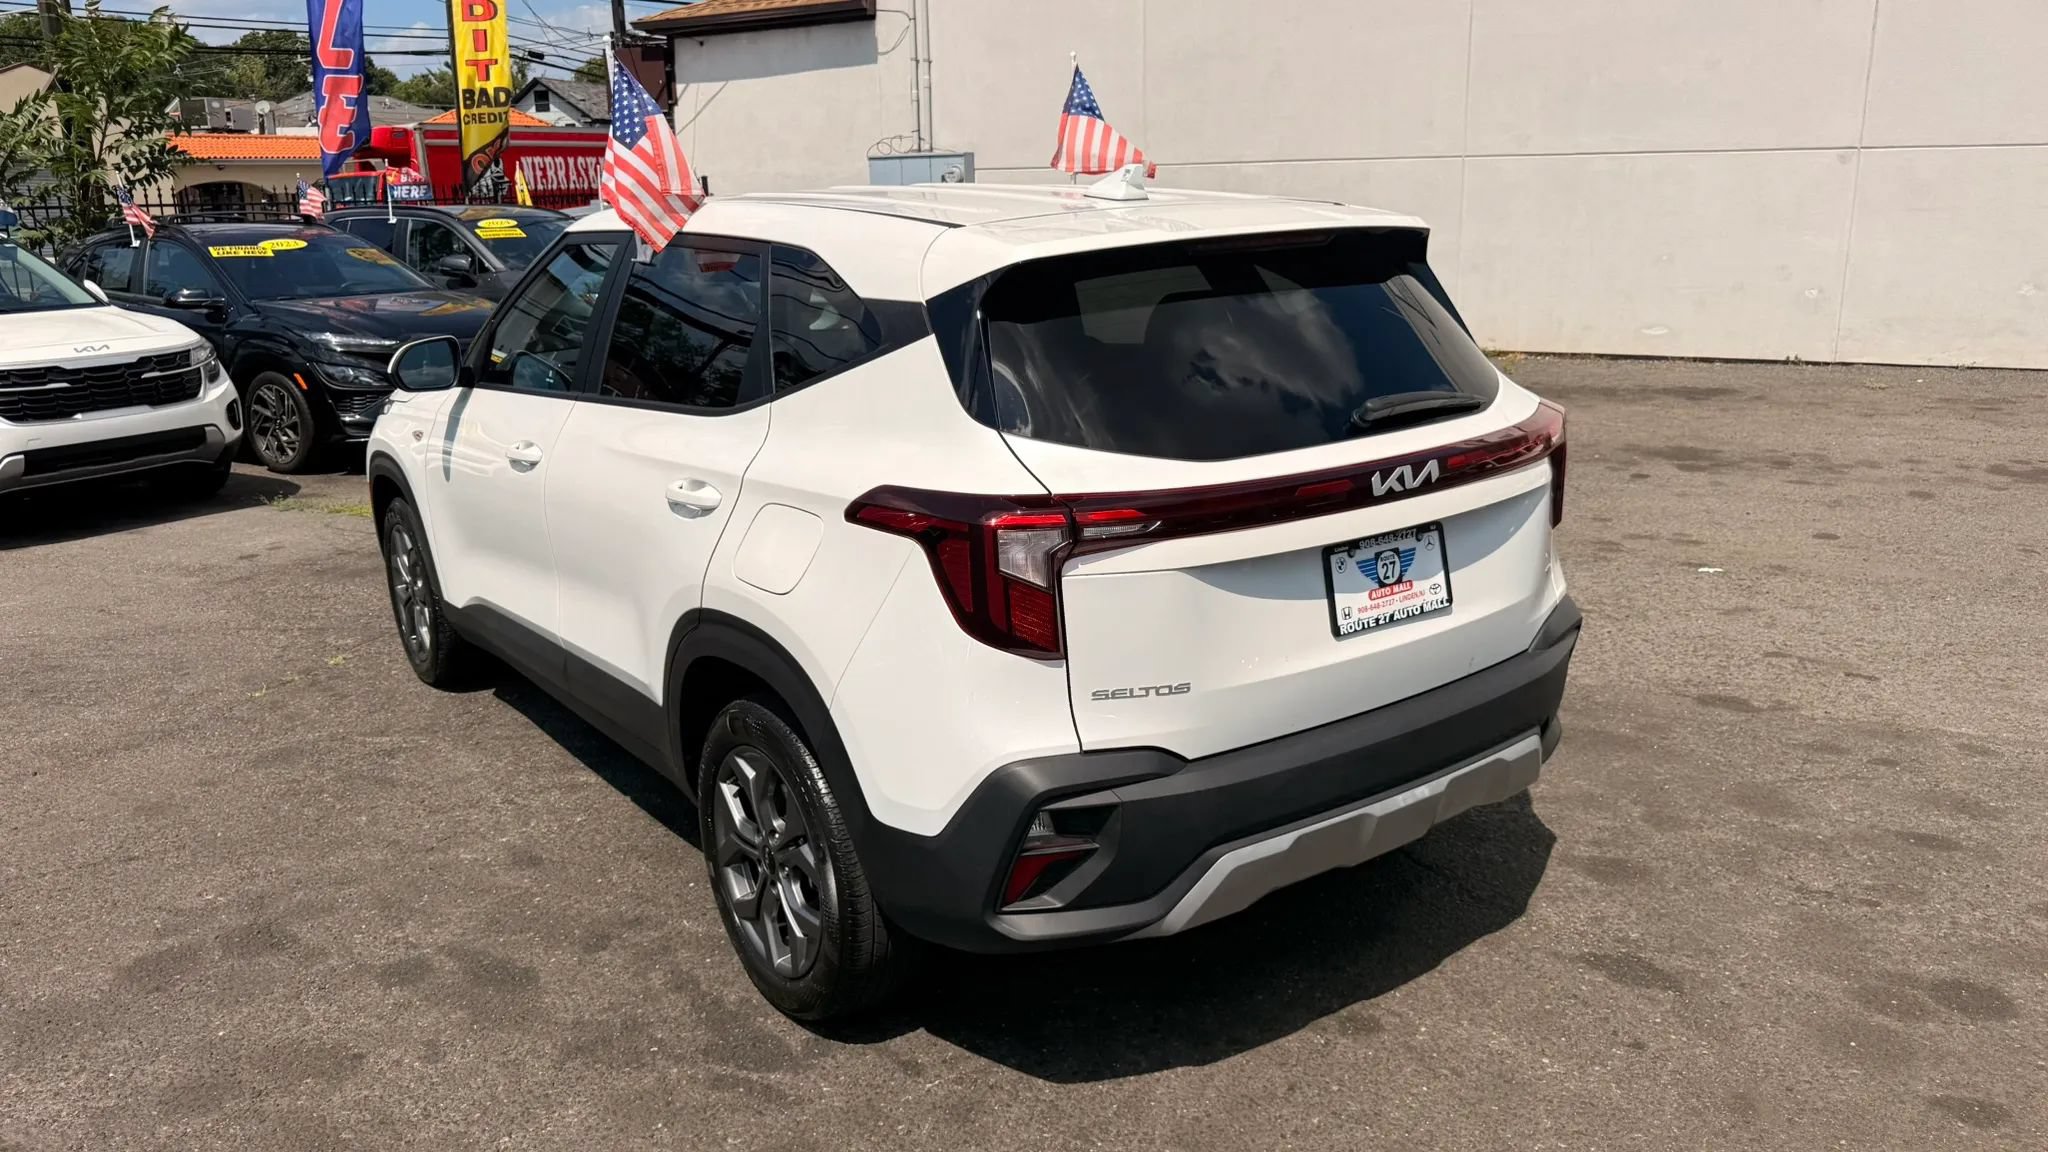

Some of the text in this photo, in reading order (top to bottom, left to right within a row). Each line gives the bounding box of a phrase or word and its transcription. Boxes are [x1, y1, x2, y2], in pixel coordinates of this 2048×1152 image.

[461, 86, 512, 110] BAD
[462, 111, 510, 126] CREDIT
[520, 155, 606, 191] NEBRASK
[393, 185, 428, 198] HERE
[73, 344, 110, 354] KIA
[1371, 459, 1440, 497] KIA
[1381, 560, 1396, 581] 27
[1371, 581, 1412, 600] AUTO MALL
[1339, 597, 1450, 636] ROUTE 27 AUTO MALL
[1357, 598, 1396, 615] 908-648-2727
[1090, 682, 1192, 702] SELTOS
